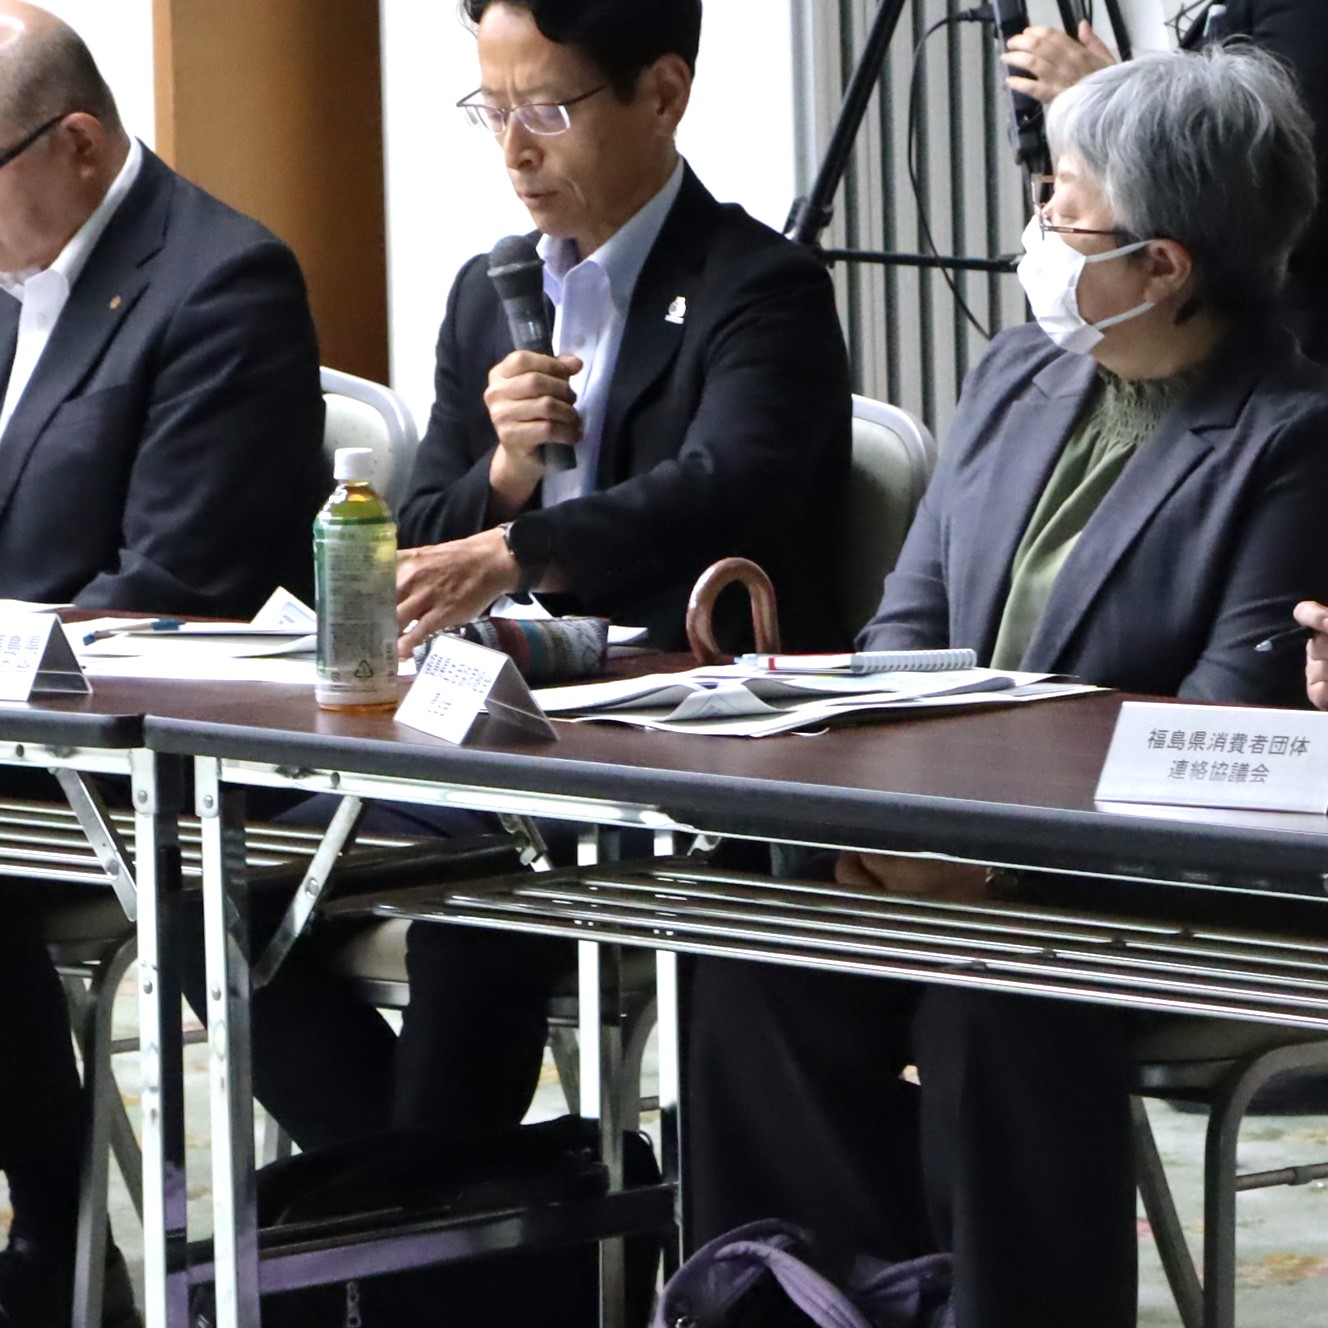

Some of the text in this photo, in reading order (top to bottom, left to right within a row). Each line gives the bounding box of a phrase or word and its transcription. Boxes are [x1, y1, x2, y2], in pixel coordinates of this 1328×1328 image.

[1147, 728, 1311, 757] 福島県消費者団体
[1168, 760, 1270, 784] 連絡協議会
